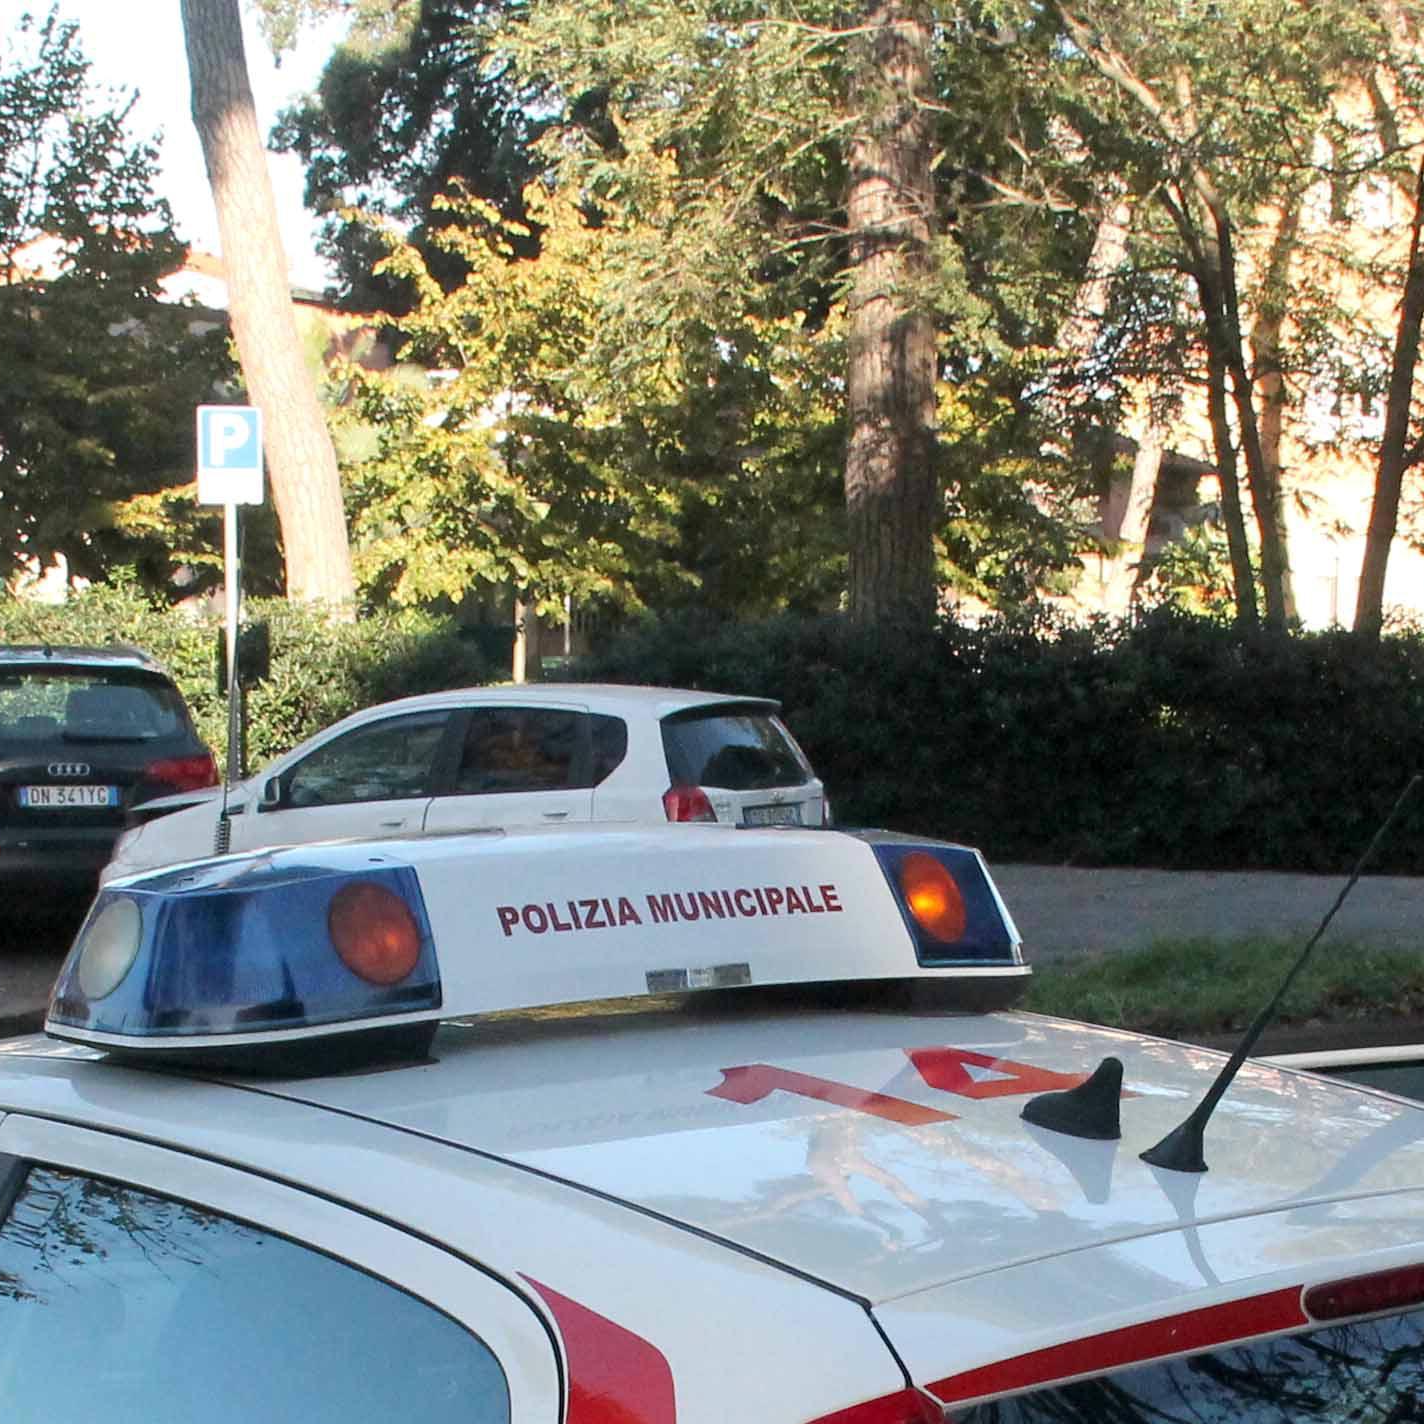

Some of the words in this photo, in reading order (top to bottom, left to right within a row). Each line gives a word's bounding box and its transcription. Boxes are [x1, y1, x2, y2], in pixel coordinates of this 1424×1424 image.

[209, 412, 250, 467] P
[496, 896, 643, 937] POLIZIA
[645, 884, 843, 923] MUNICIPALE
